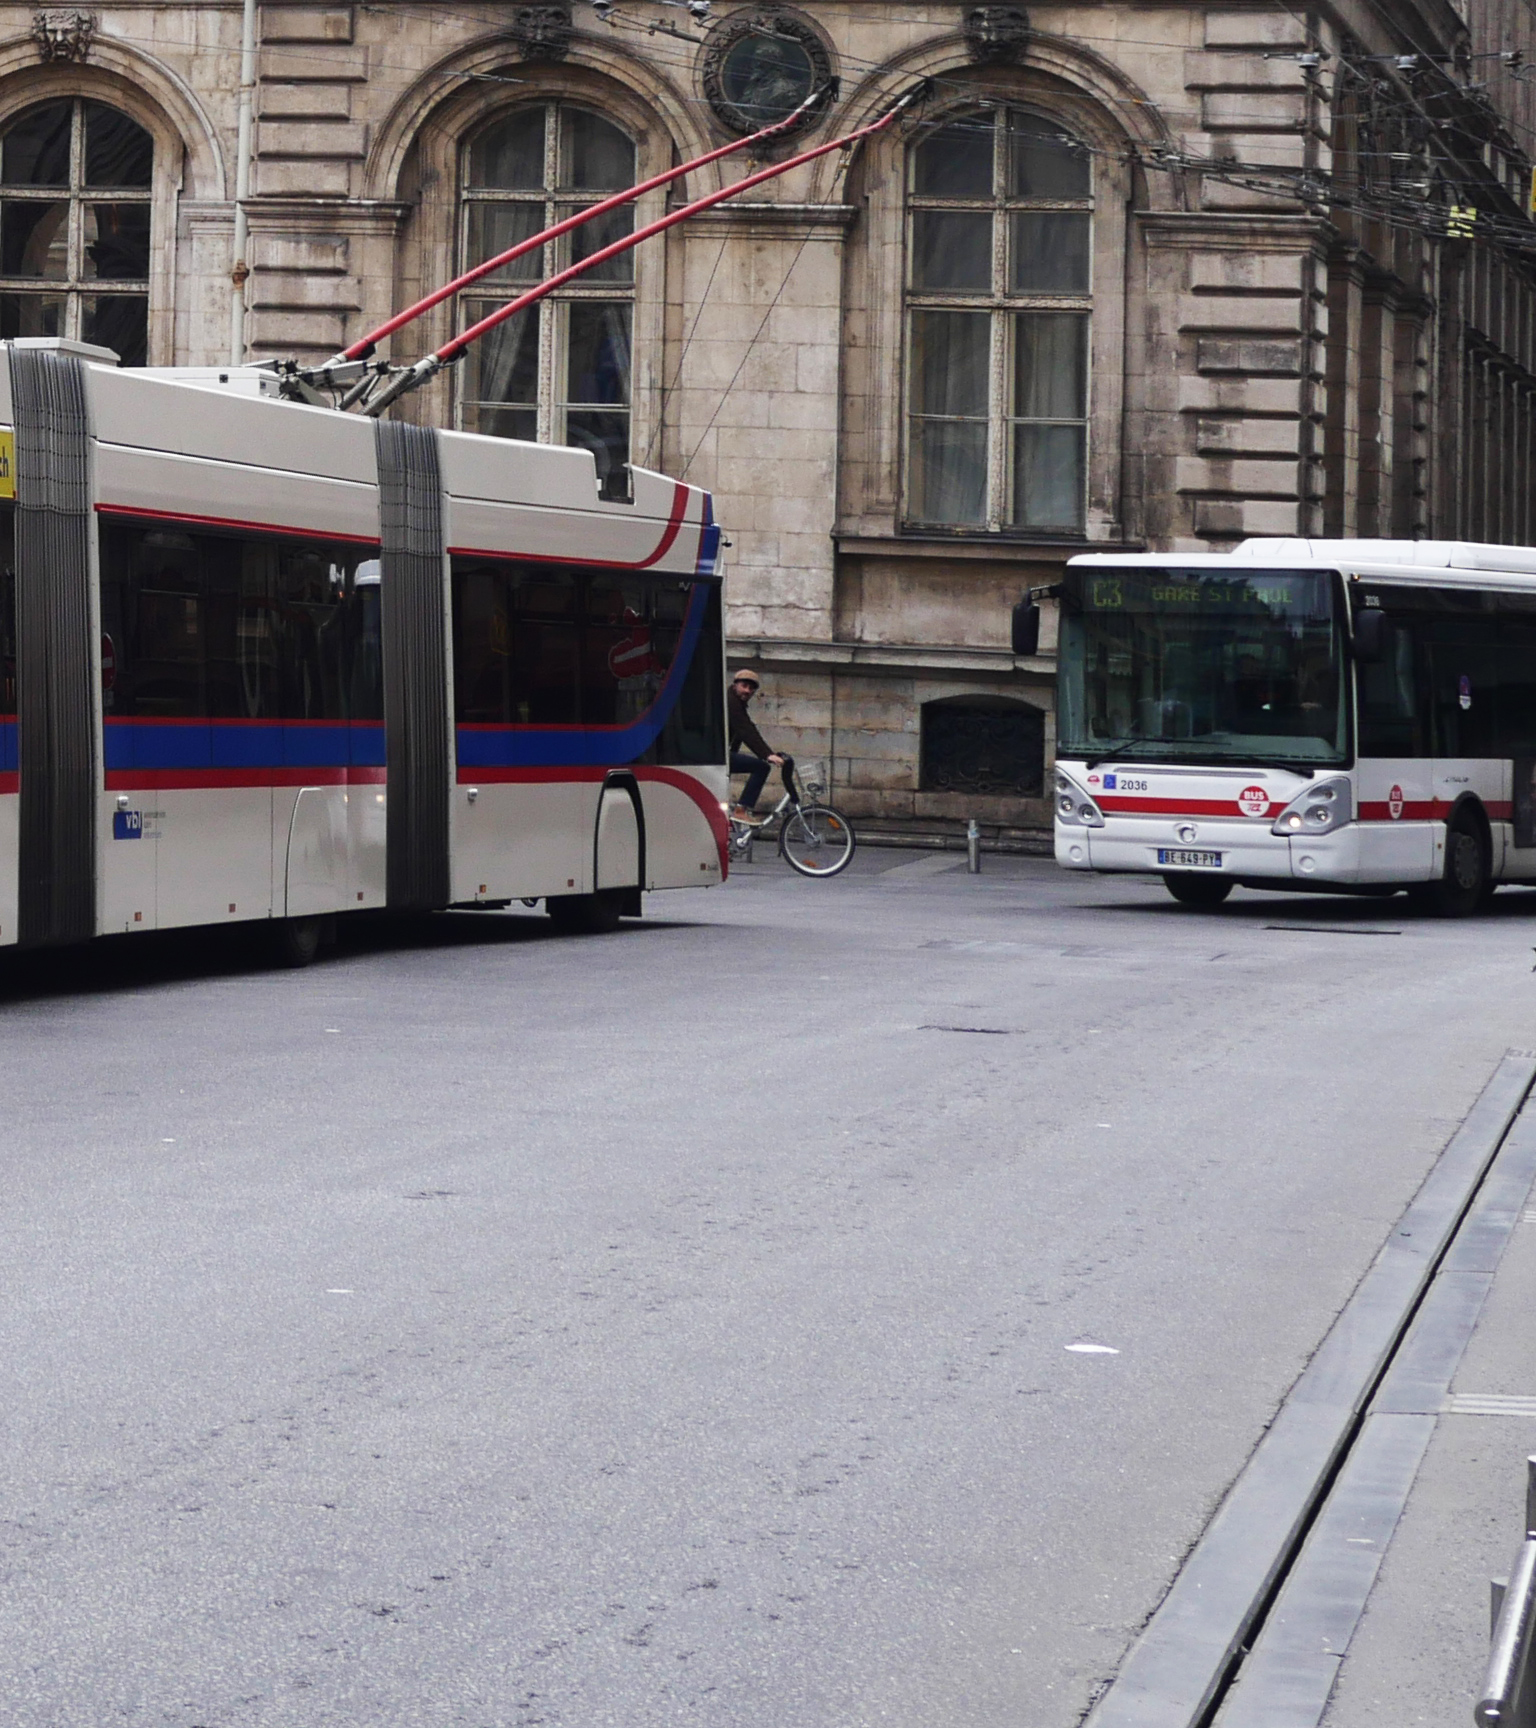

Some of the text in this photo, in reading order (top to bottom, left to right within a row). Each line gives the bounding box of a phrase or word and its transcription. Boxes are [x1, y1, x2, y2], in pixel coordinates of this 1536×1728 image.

[1092, 579, 1123, 608] C3
[1151, 585, 1200, 602] GARE
[1208, 585, 1231, 602] ST
[1120, 779, 1148, 791] 2036
[1244, 790, 1265, 801] BUS
[126, 811, 141, 830] vbl
